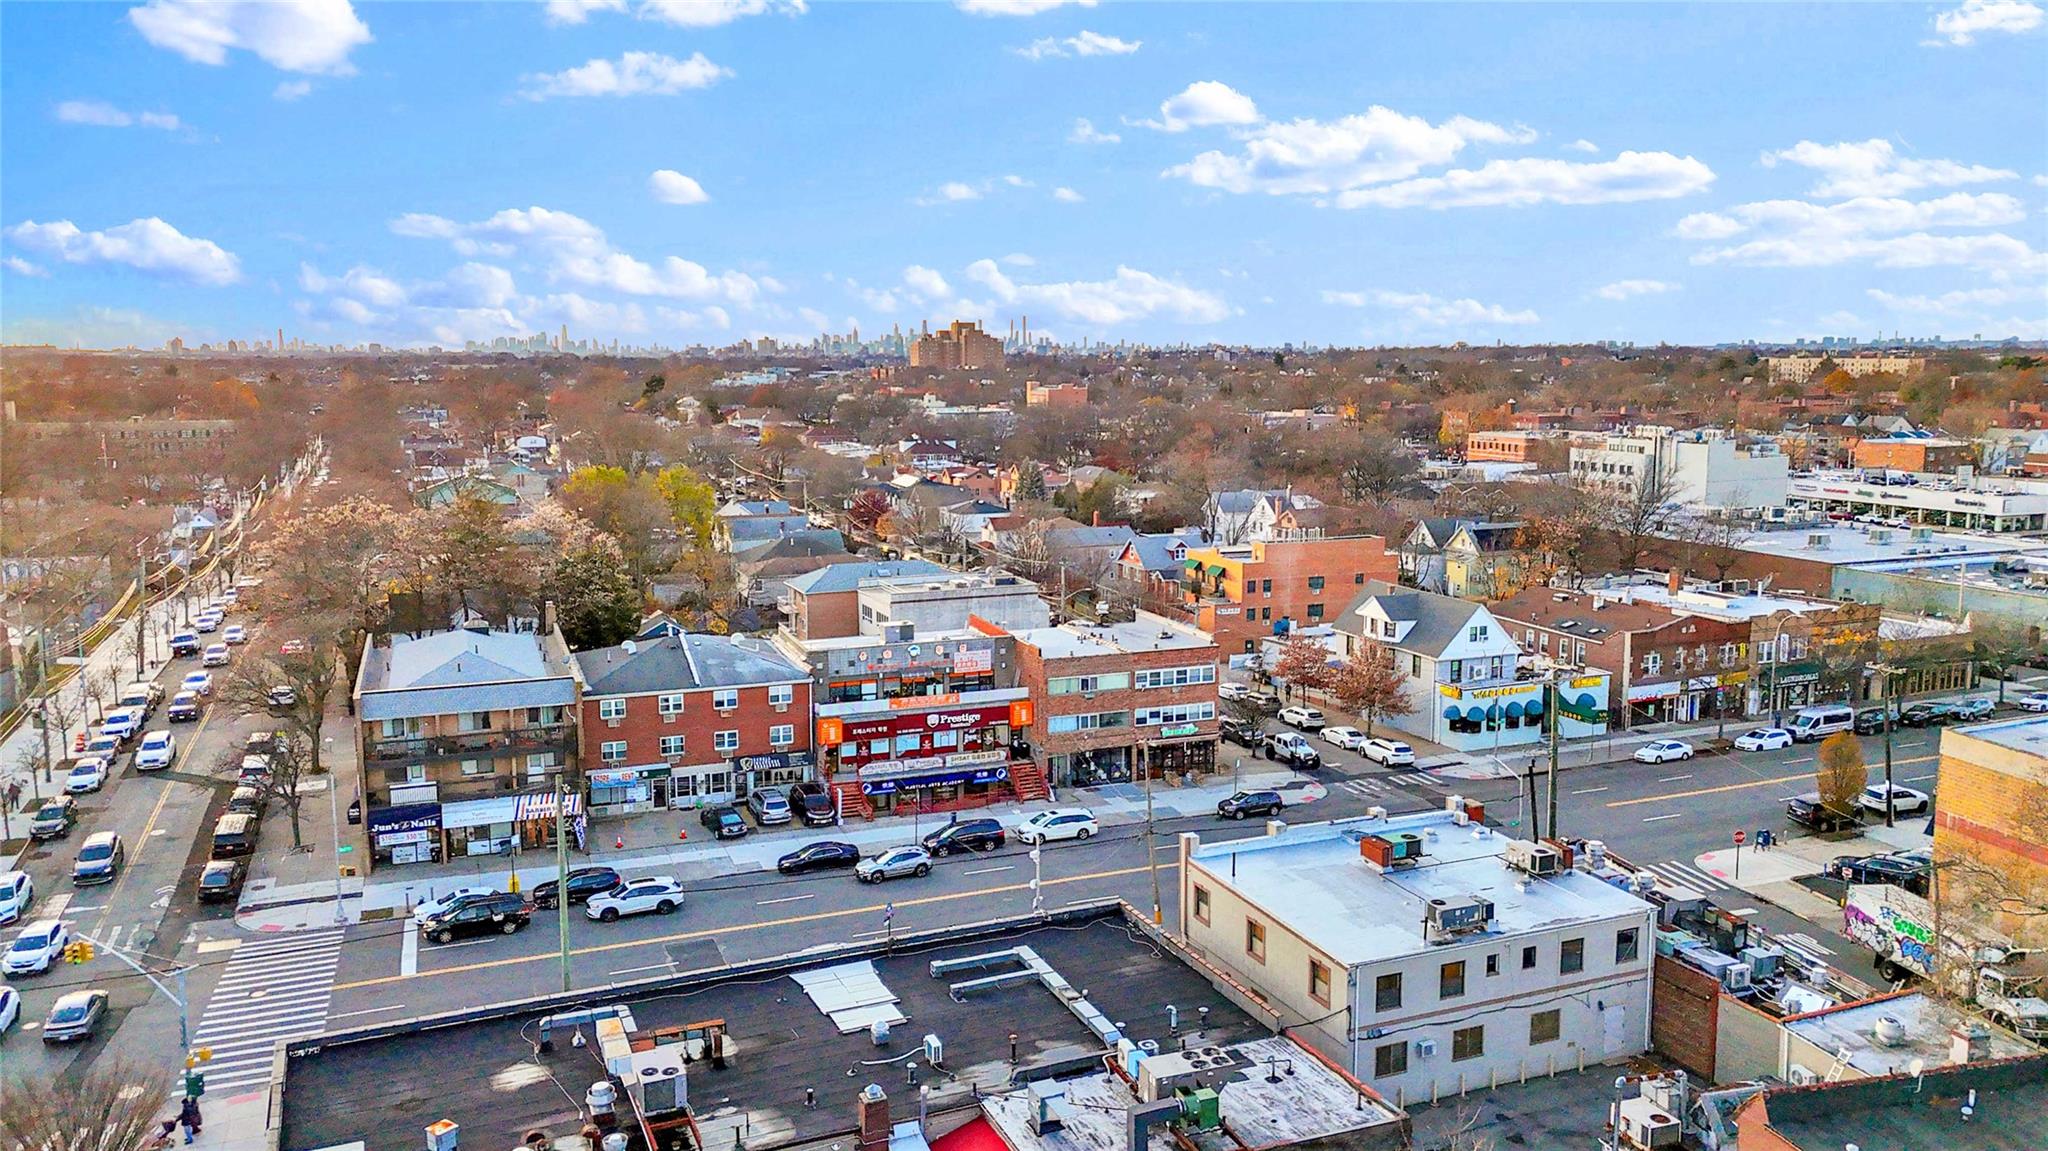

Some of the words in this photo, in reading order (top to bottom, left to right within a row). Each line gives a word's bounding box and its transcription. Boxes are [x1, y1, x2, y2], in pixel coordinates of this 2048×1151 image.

[940, 713, 980, 723] Prestige
[371, 822, 399, 832] Jun's
[411, 819, 437, 828] Nails
